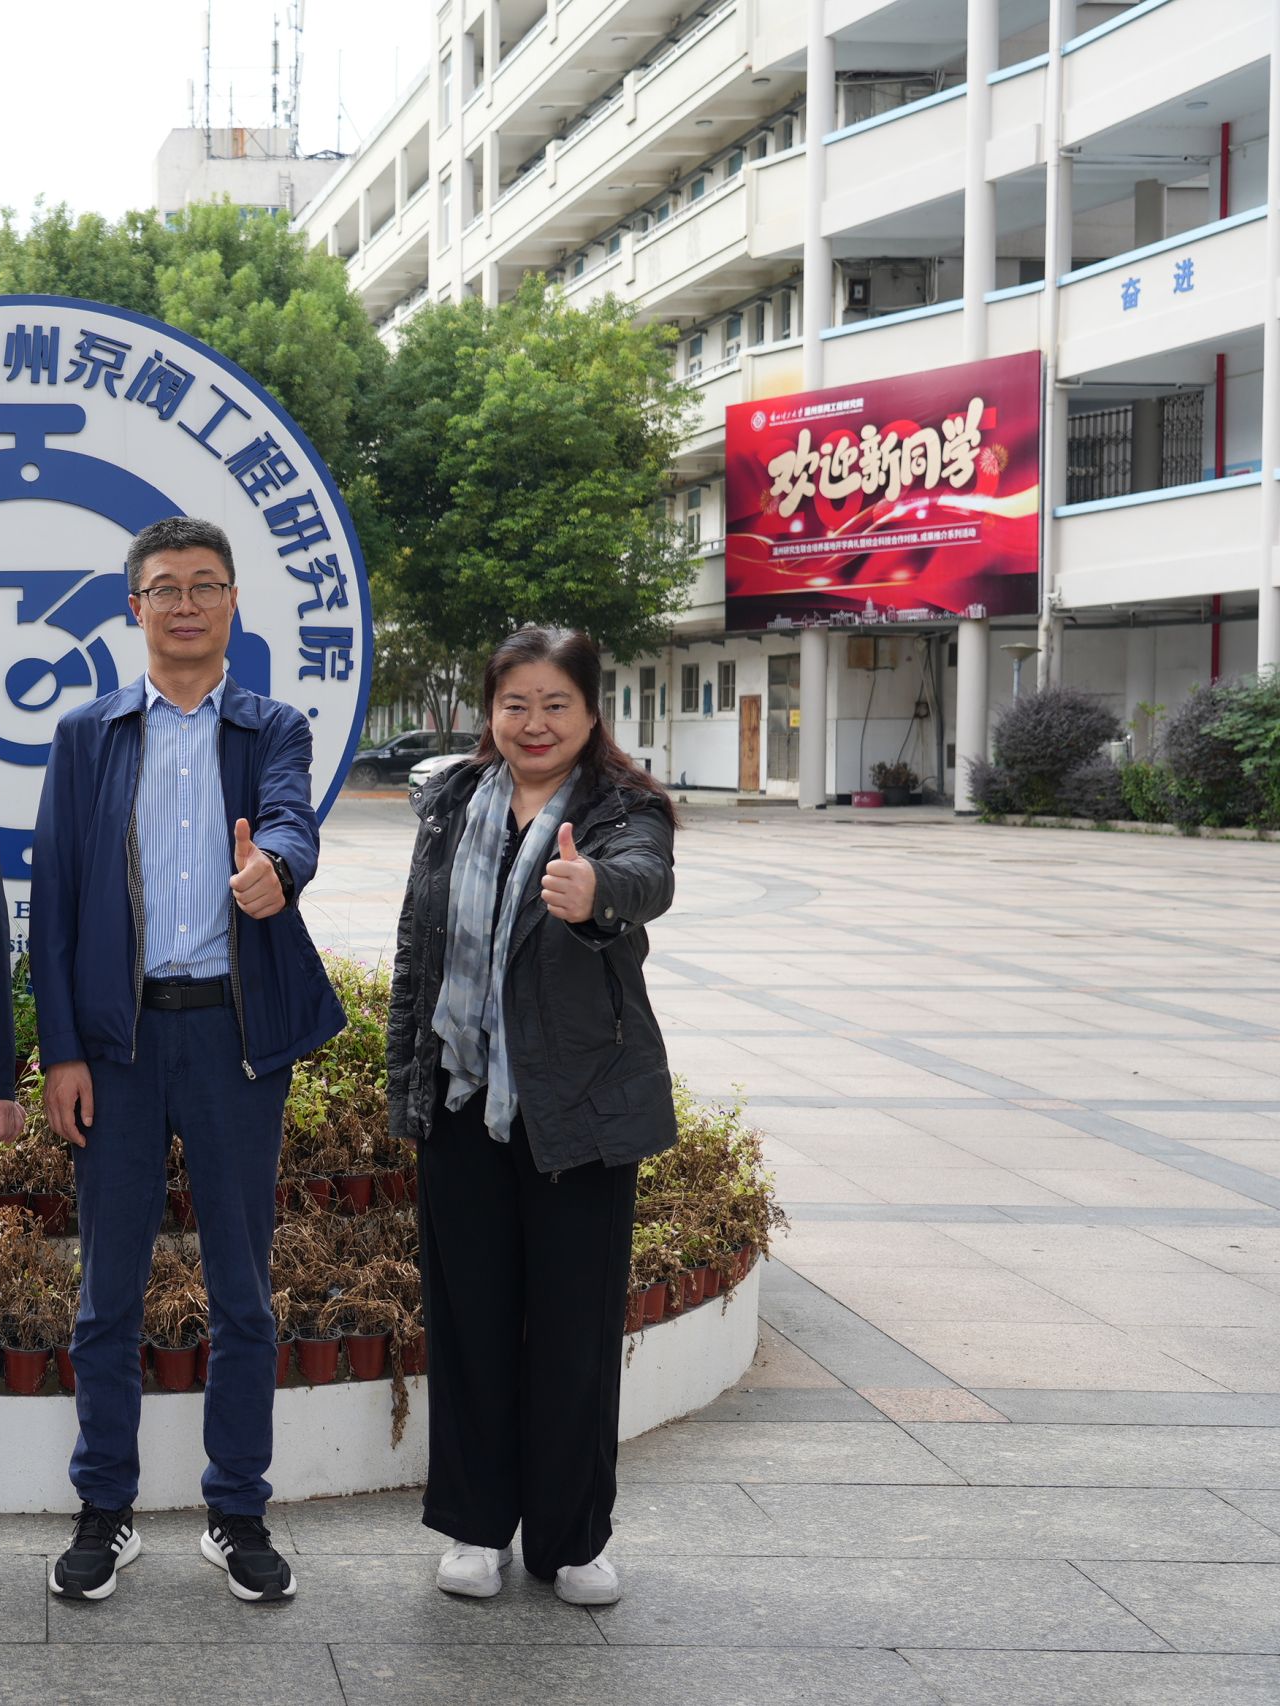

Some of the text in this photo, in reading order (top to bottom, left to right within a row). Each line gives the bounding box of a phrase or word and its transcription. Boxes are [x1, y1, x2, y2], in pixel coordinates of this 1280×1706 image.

[1121, 258, 1194, 311] 奋进
[768, 397, 984, 517] 欢迎新同学
